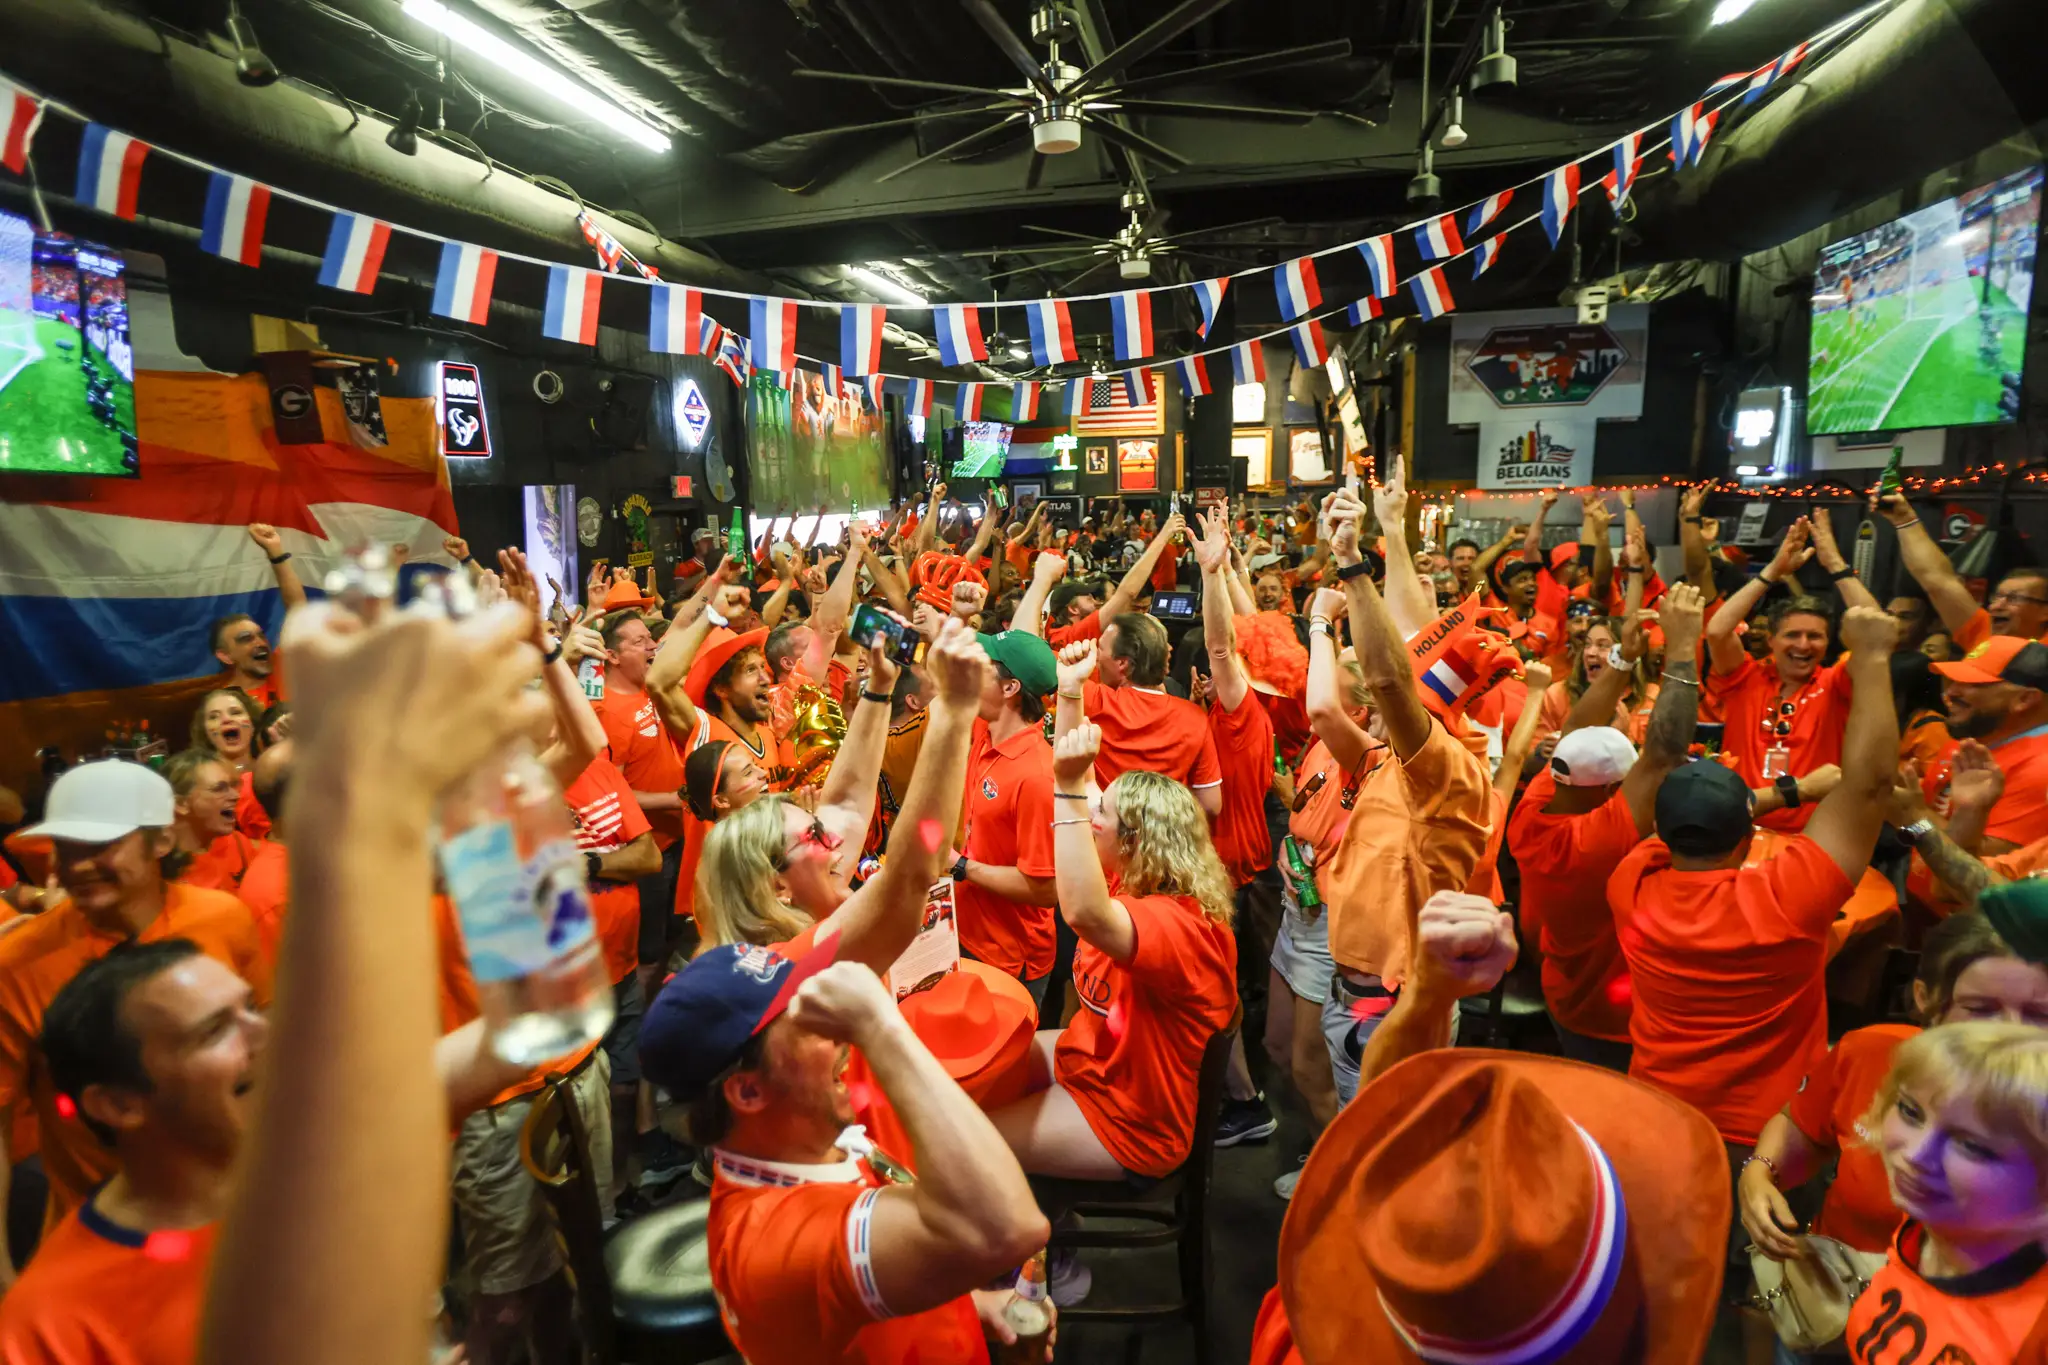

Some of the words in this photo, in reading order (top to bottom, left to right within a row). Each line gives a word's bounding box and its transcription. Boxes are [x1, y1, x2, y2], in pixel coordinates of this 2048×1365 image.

[1496, 465, 1571, 479] BELGIANS
[1198, 490, 1211, 499] NO
[1413, 610, 1465, 658] HOLLAND
